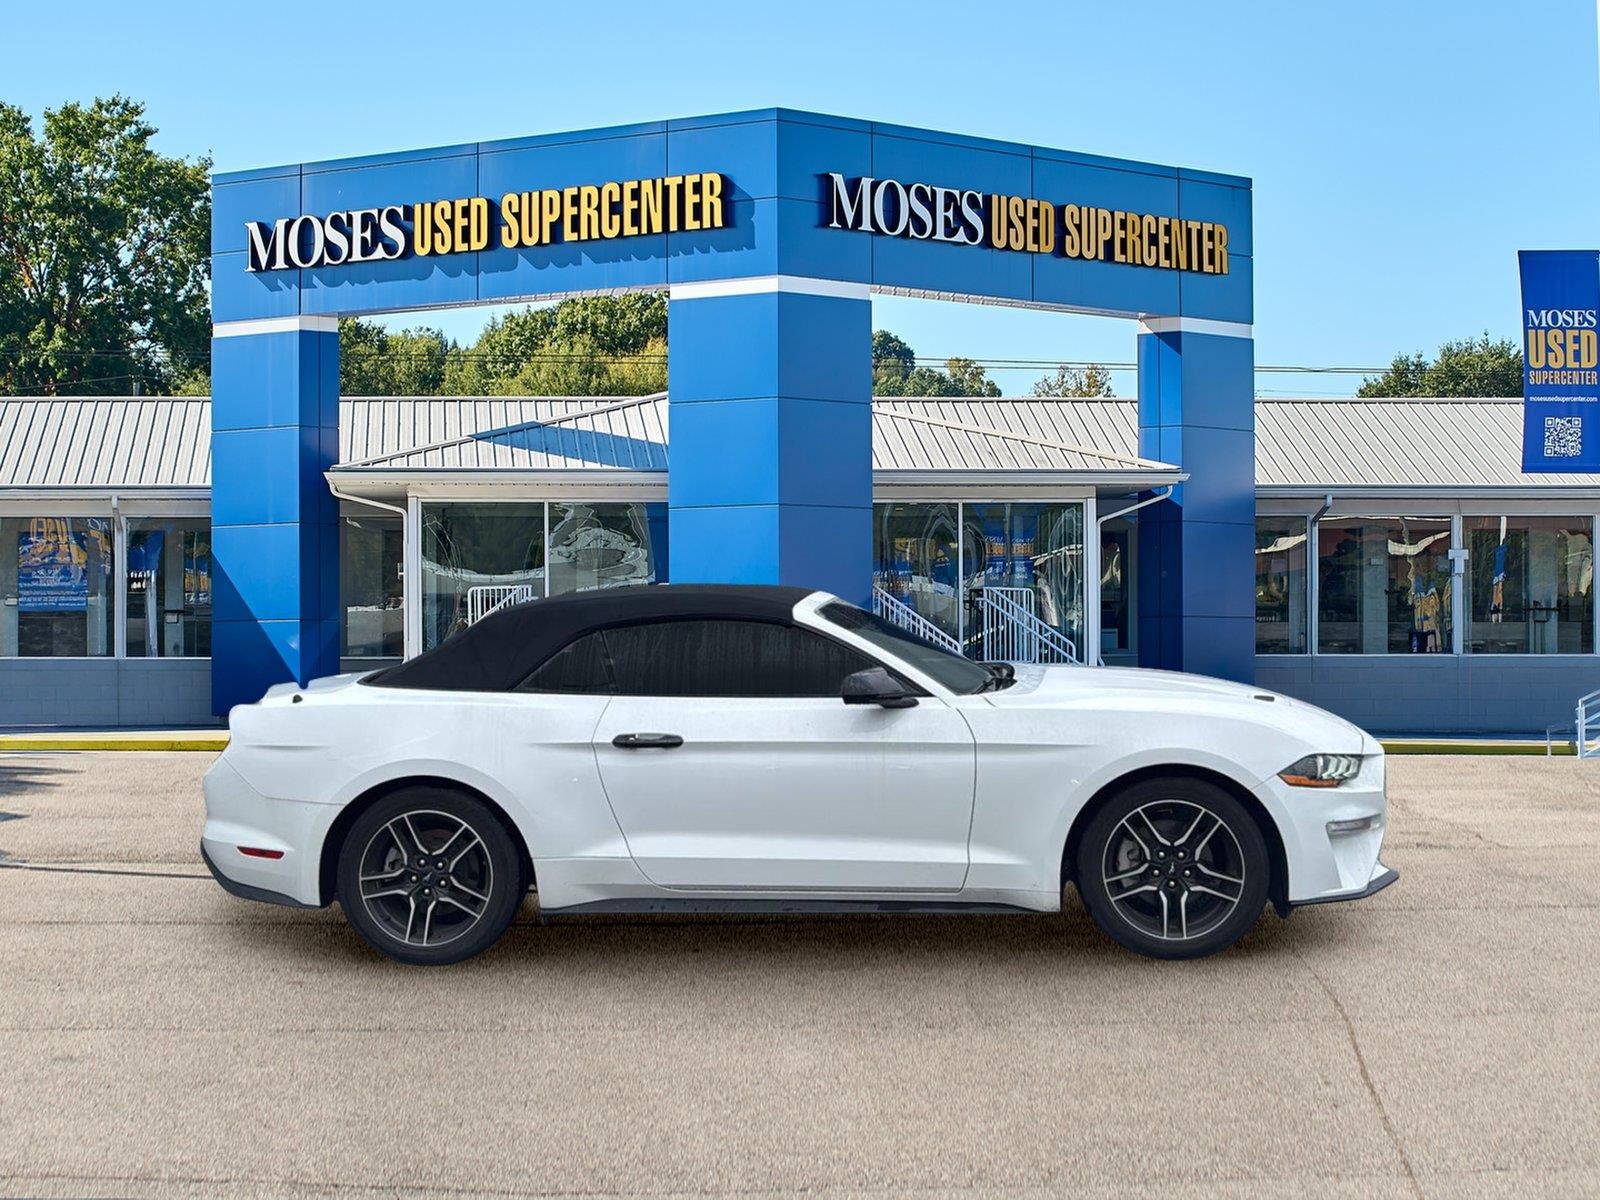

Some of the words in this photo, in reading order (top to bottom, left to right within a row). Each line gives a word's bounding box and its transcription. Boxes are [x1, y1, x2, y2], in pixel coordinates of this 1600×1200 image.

[244, 205, 406, 273] MOSES
[413, 196, 488, 256] USED
[501, 172, 723, 248] SUPERCENTER
[829, 173, 984, 246] MOSES
[991, 194, 1055, 254] USED
[1065, 204, 1229, 275] SUPERCENTER
[1527, 309, 1597, 328] MOSES
[1528, 329, 1598, 369] USED
[1529, 370, 1598, 385] SUPERCENTER
[1529, 395, 1598, 403] mosesusedsupercenter.com
